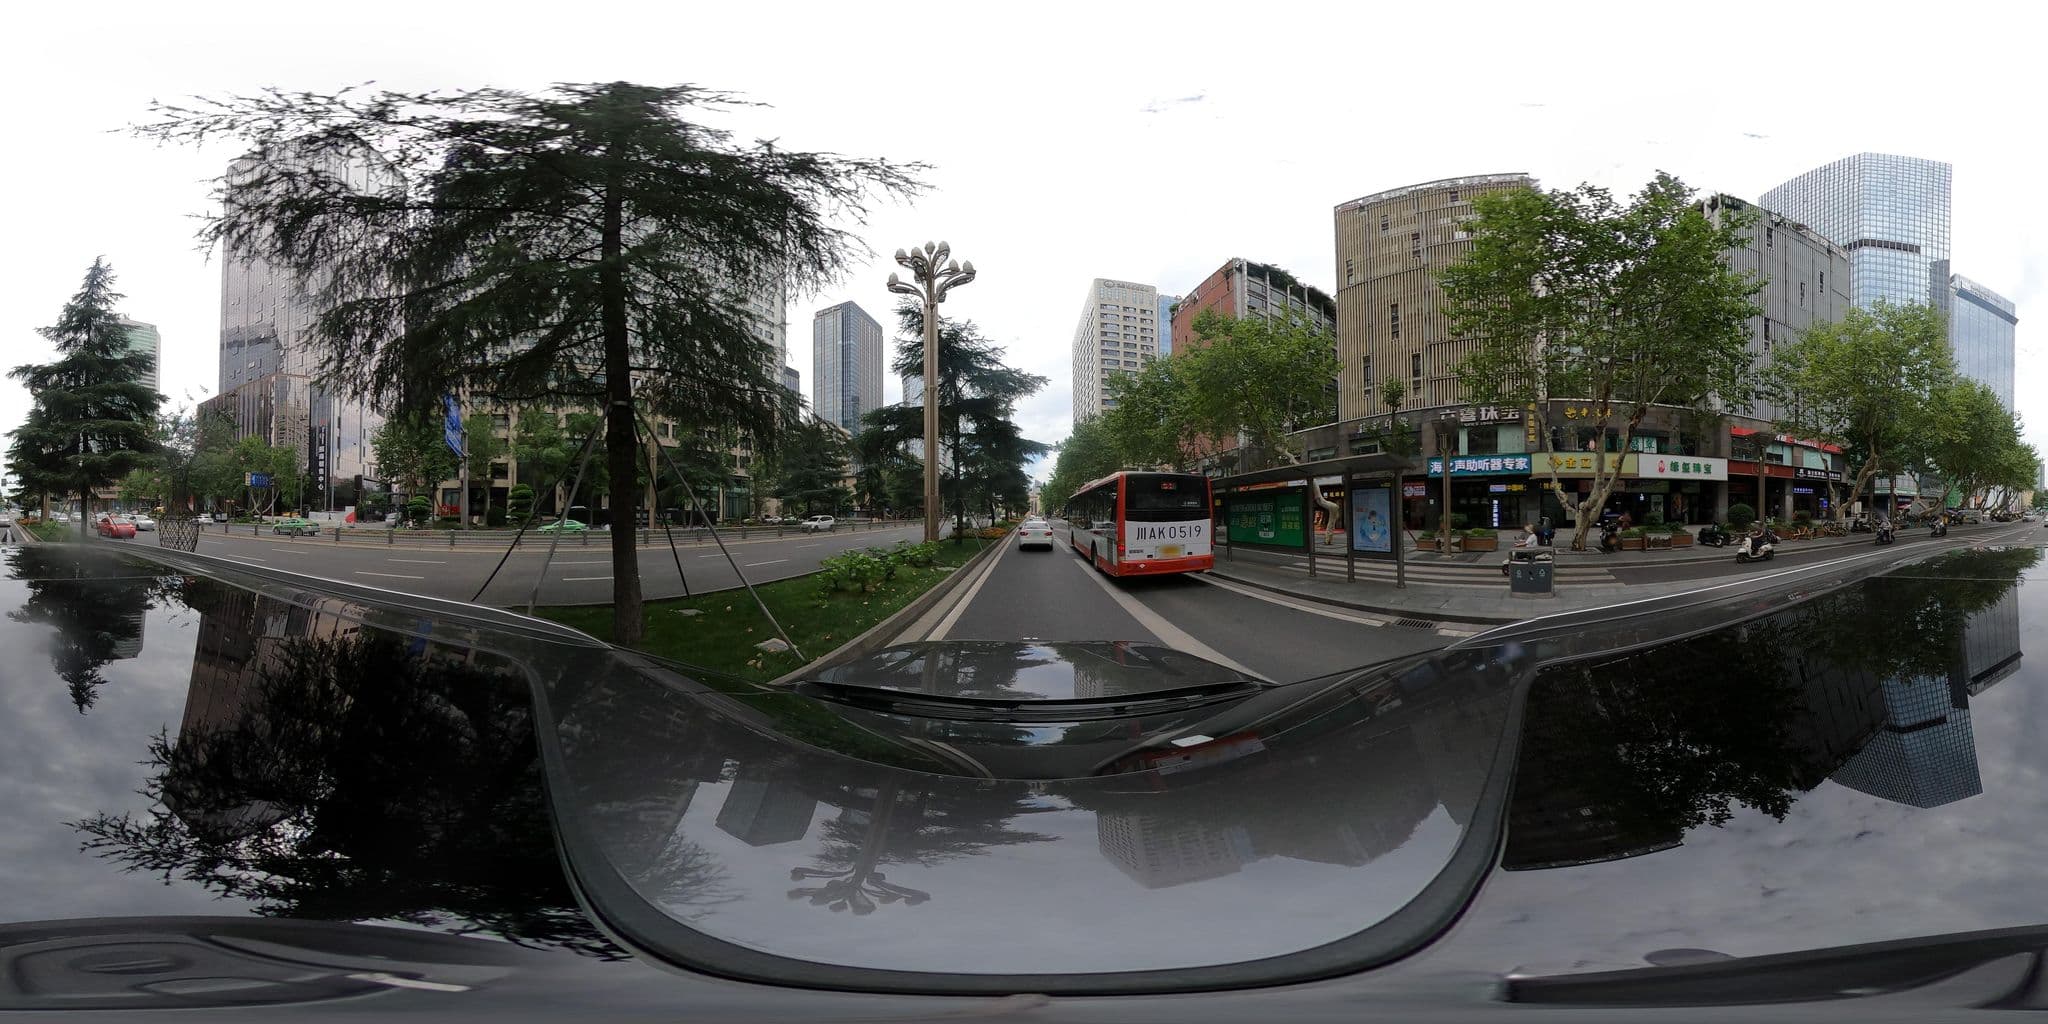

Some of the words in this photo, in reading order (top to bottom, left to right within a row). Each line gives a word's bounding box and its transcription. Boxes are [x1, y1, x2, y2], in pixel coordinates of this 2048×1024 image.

[1430, 457, 1528, 473] 海之声助听器专家
[1136, 525, 1202, 540] 川AK0519
